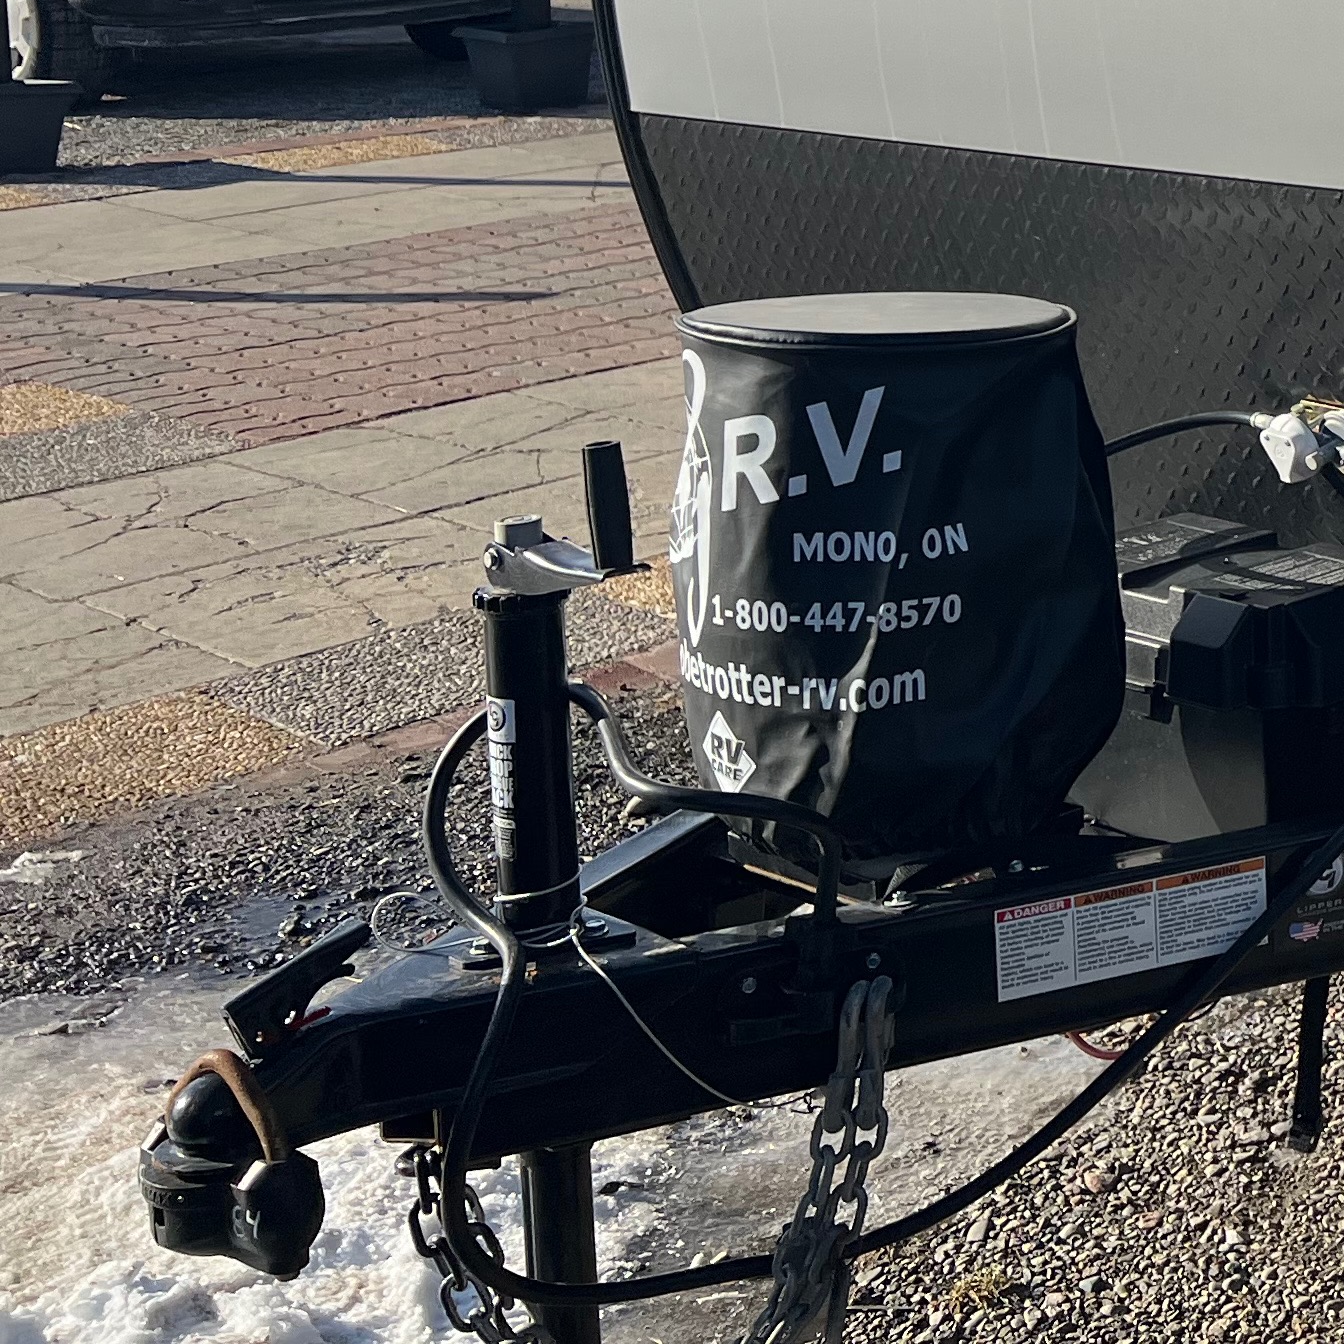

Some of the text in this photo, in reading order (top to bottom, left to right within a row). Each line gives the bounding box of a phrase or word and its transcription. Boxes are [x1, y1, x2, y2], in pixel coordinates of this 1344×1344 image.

[720, 385, 902, 513] R.V.
[793, 522, 969, 570] MONO, ON
[711, 593, 963, 633] 1-800-447-8570
[711, 731, 743, 765] RV
[711, 757, 742, 781] CARE
[1187, 863, 1240, 884] WARNING
[1091, 883, 1146, 904] WARNING
[1013, 899, 1066, 919] DANGER
